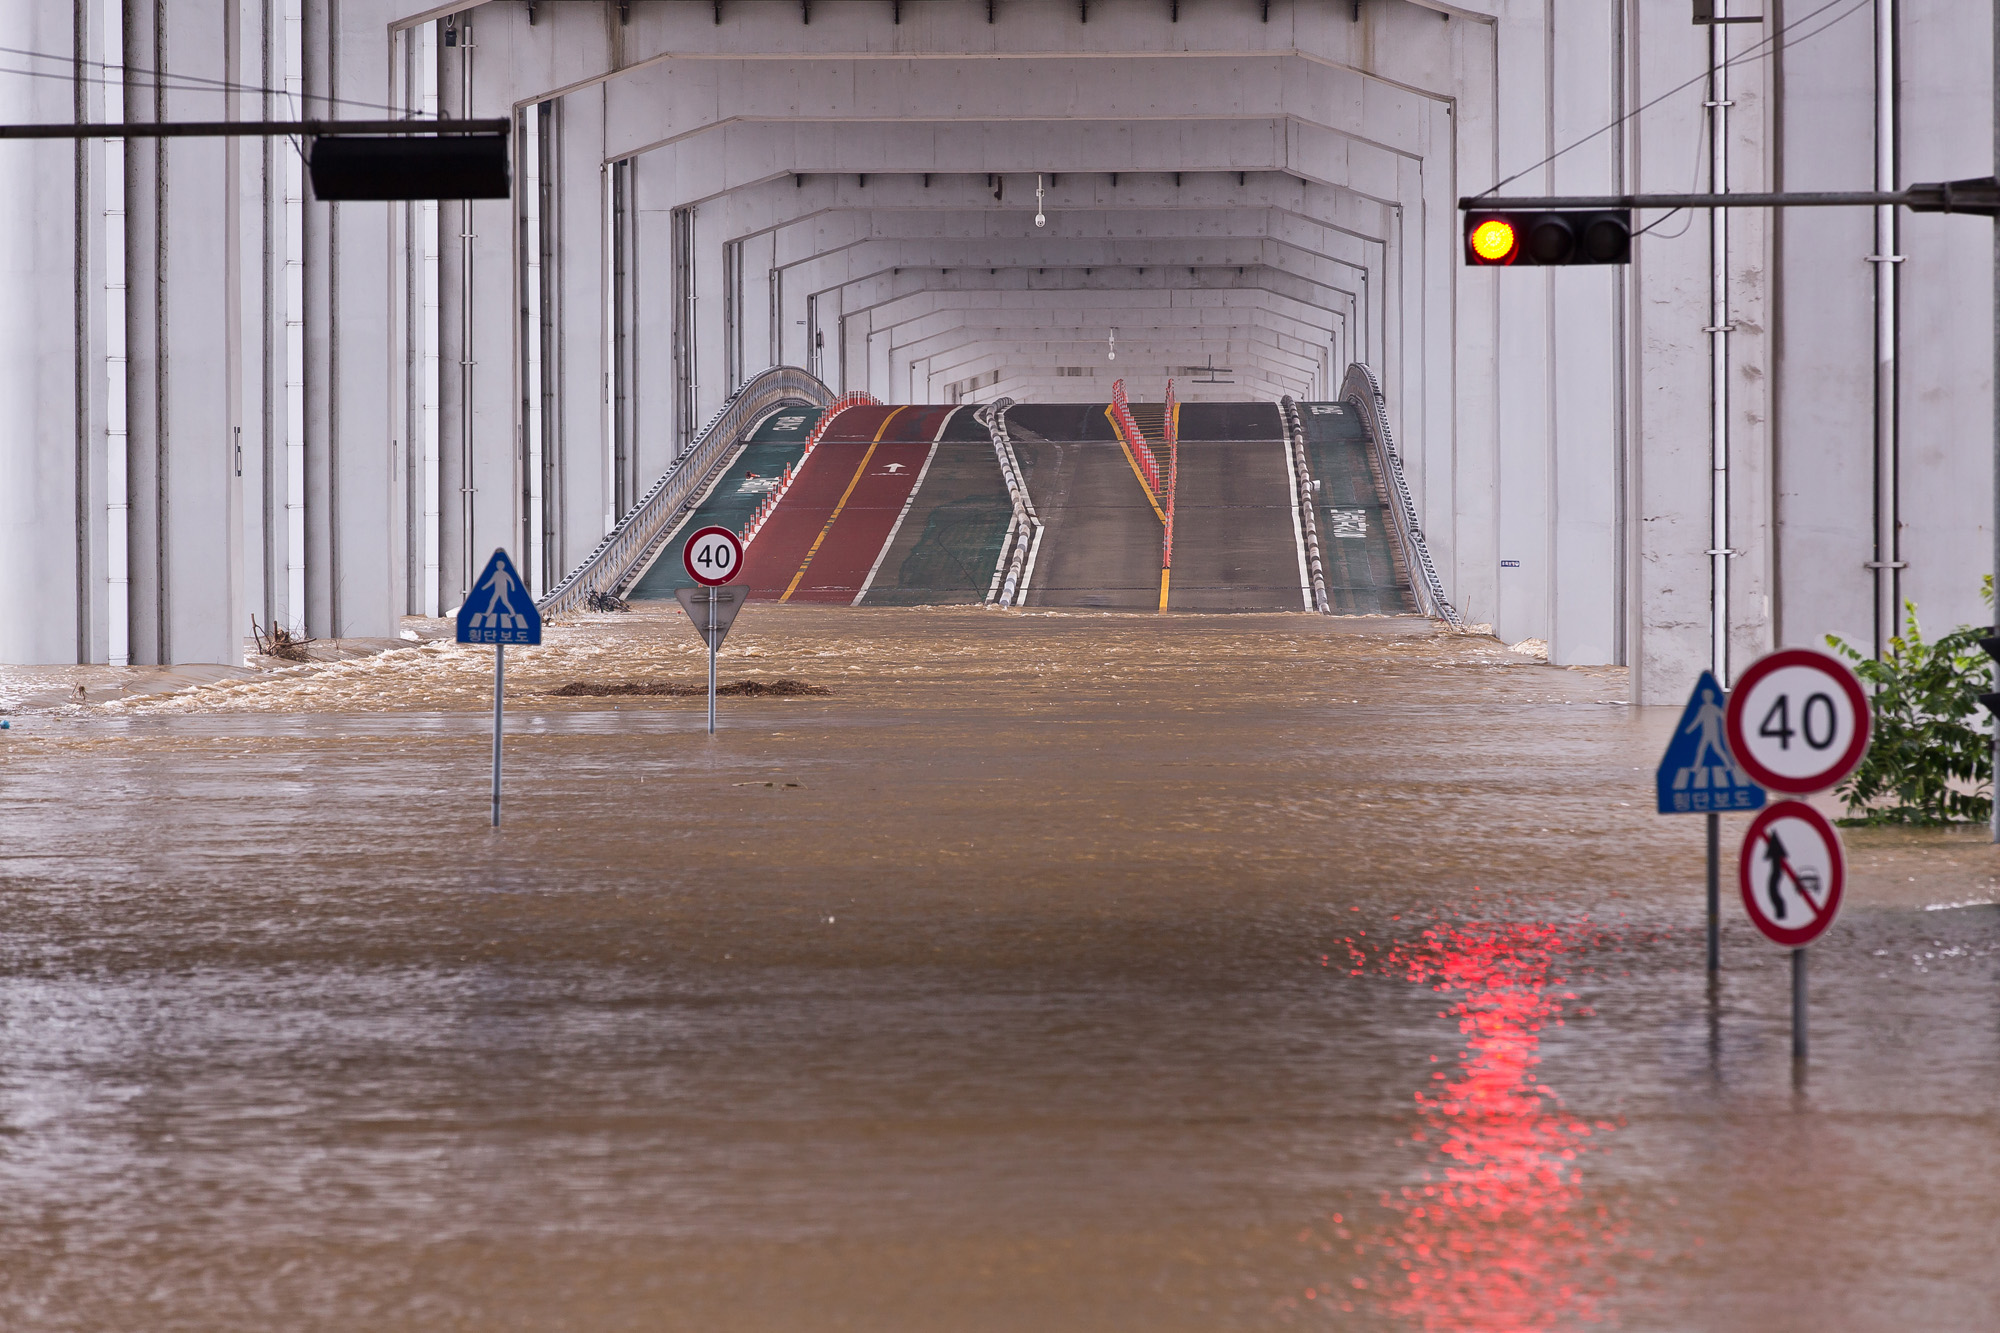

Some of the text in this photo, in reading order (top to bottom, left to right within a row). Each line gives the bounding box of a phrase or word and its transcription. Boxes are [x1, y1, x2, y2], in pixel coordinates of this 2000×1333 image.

[697, 544, 730, 568] 40
[468, 629, 529, 642] 횡단보도
[1758, 692, 1837, 750] 40
[1672, 790, 1752, 811] 횡단보도
